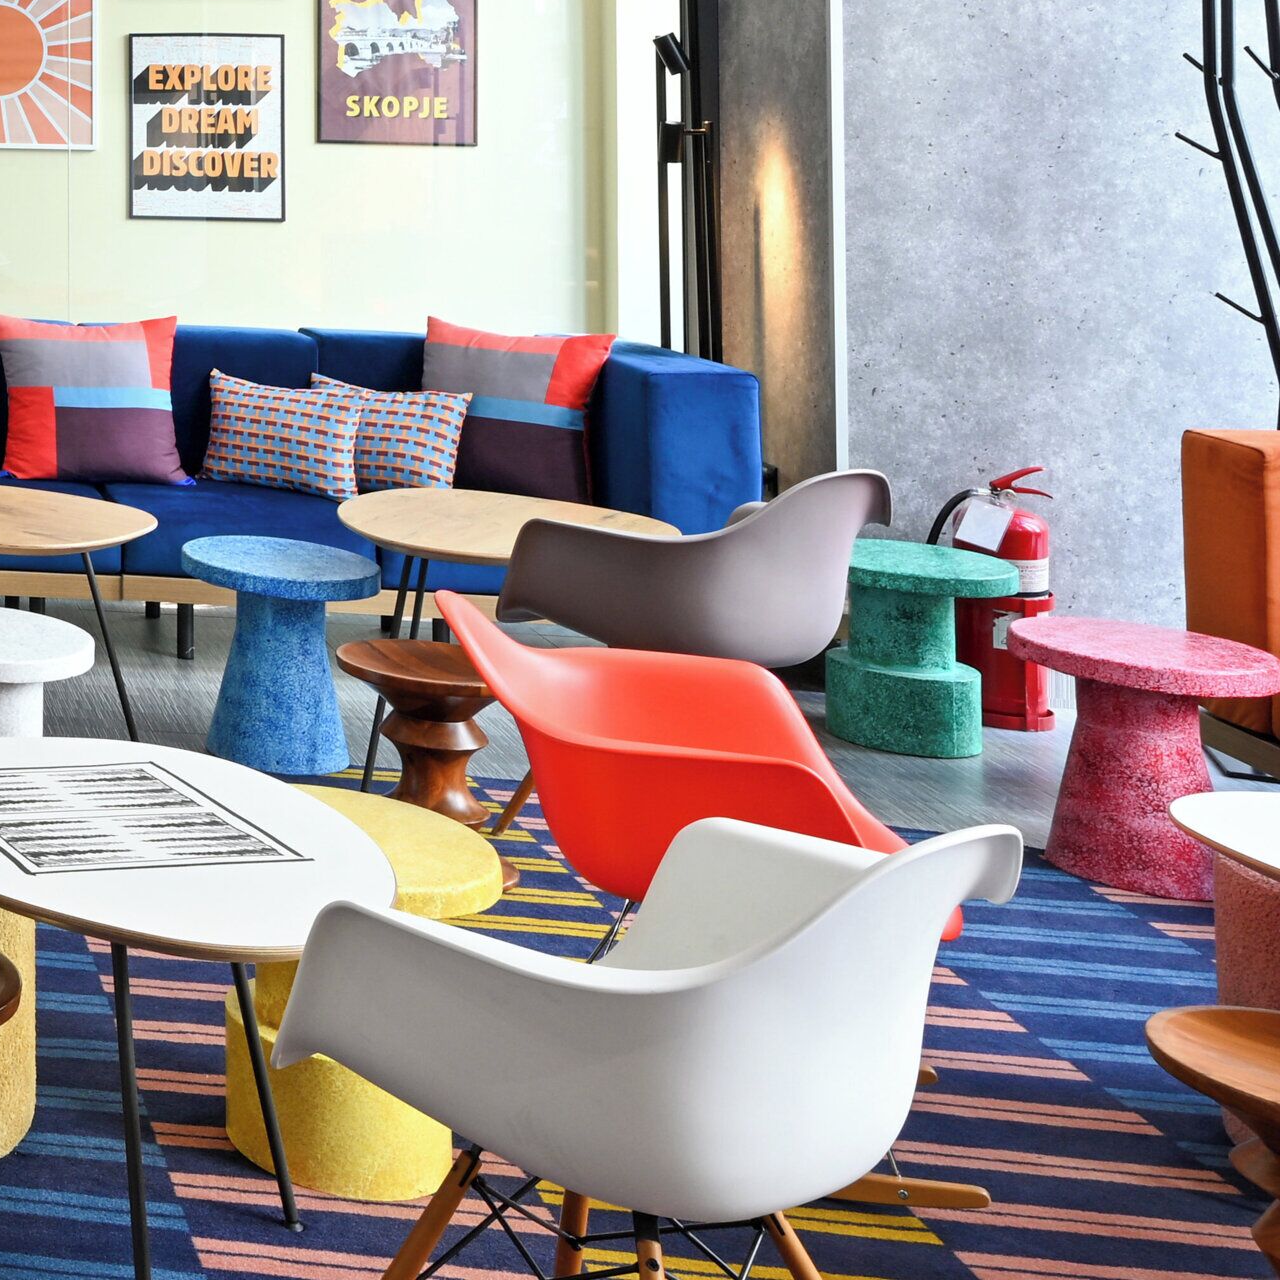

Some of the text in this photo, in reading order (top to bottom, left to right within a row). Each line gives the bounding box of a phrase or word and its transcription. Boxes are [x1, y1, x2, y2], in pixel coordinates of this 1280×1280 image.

[148, 64, 273, 91] EXPLORE
[161, 107, 259, 134] DREAM
[346, 95, 448, 119] SKOPJE
[143, 150, 279, 178] DISCOVER
